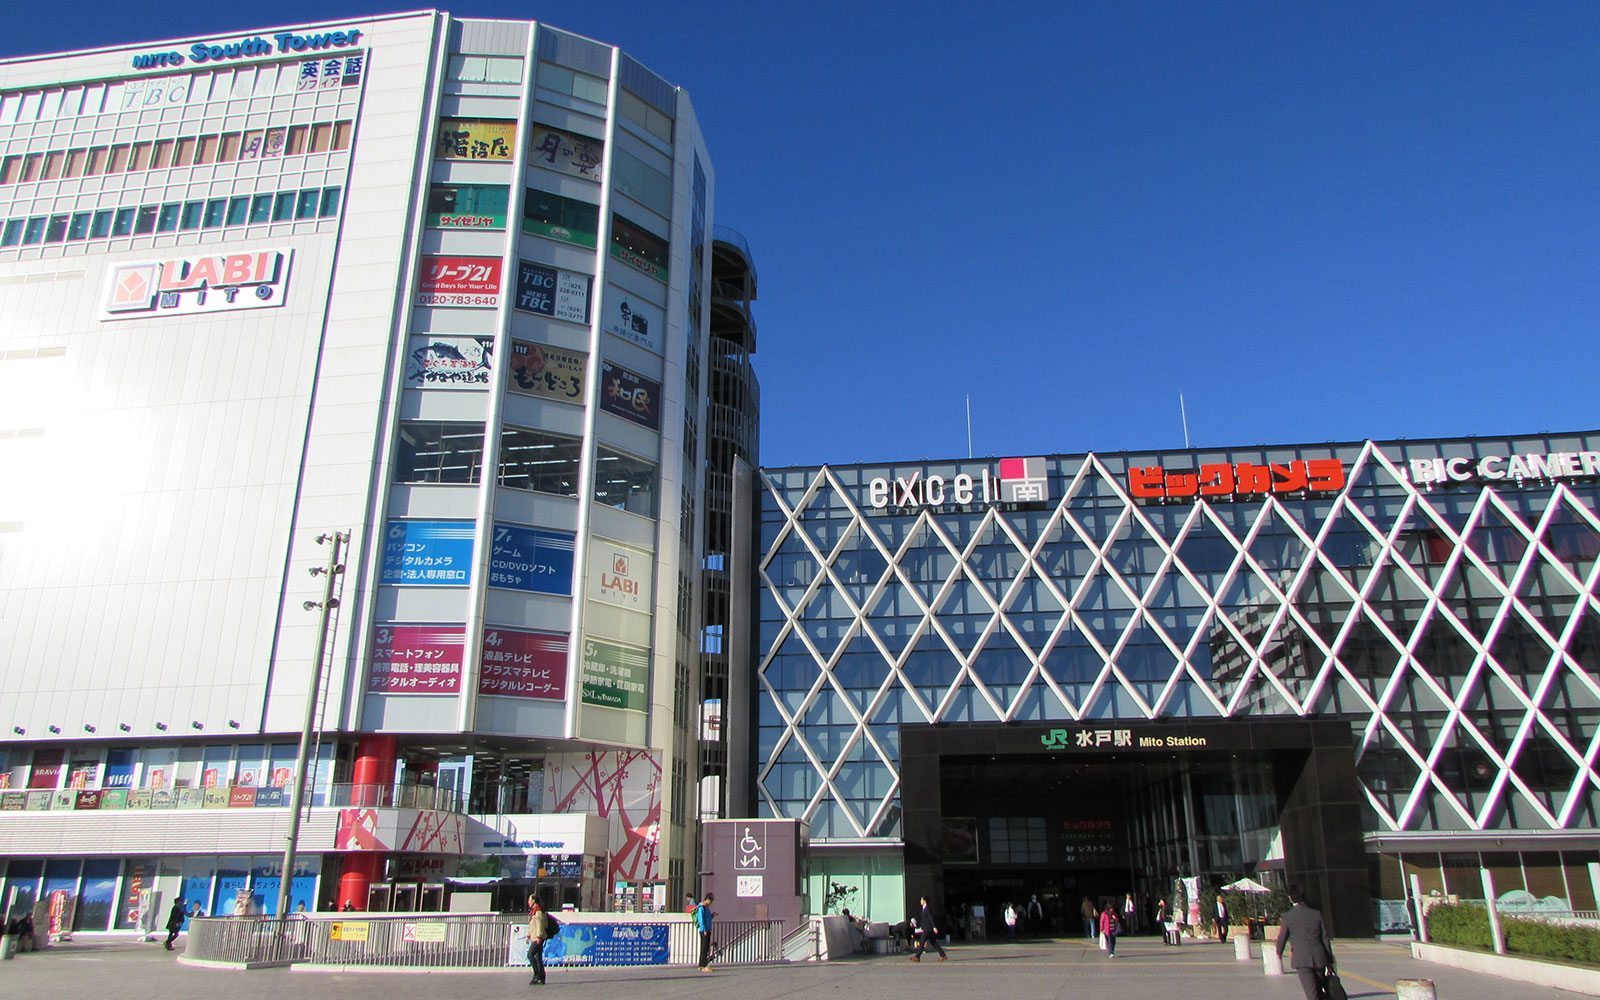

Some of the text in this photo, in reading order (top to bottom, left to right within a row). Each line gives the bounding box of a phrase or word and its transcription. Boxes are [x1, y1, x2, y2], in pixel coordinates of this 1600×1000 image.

[132, 28, 362, 69] MITO South Tower
[301, 56, 363, 79] 英会話
[299, 78, 340, 90] ソフィア
[440, 215, 494, 228] サイゼリヤ
[620, 249, 659, 275] サイゼリヤ
[159, 252, 279, 291] LABI
[430, 264, 493, 281] リーブ21
[522, 272, 554, 288] TBC
[161, 284, 273, 308] MITO
[419, 295, 497, 305] 0120-783-640
[521, 295, 551, 311] TBC
[515, 345, 528, 354] 11F
[1128, 458, 1345, 497] ビックカメラ
[1410, 457, 1471, 484] BIC
[869, 468, 990, 508] excel
[389, 525, 406, 538] 6F
[495, 528, 512, 543] 7F
[387, 543, 426, 552] パソコン
[494, 546, 521, 557] ゲーム
[386, 556, 453, 566] デジタルカメラ
[492, 560, 556, 575] CD/DVDソフト
[490, 572, 522, 584] おもちゃ
[601, 573, 639, 595] LABI
[601, 588, 638, 602] MITO
[377, 629, 394, 644] 3F
[486, 631, 504, 646] 4F
[374, 648, 444, 658] スマートフォン
[484, 650, 533, 664] 液晶テレビ
[585, 642, 598, 657] 5F
[483, 664, 551, 679] プラズマテレビ
[371, 676, 457, 687] デジタルオーディオ
[481, 678, 560, 693] デジタルレコーダー
[1041, 729, 1069, 745] JR
[1076, 730, 1206, 747] 水戸駅 Mito Station
[504, 840, 534, 849] South
[533, 839, 565, 849] Tower
[1078, 845, 1113, 853] レストラン
[416, 859, 445, 868] LABI
